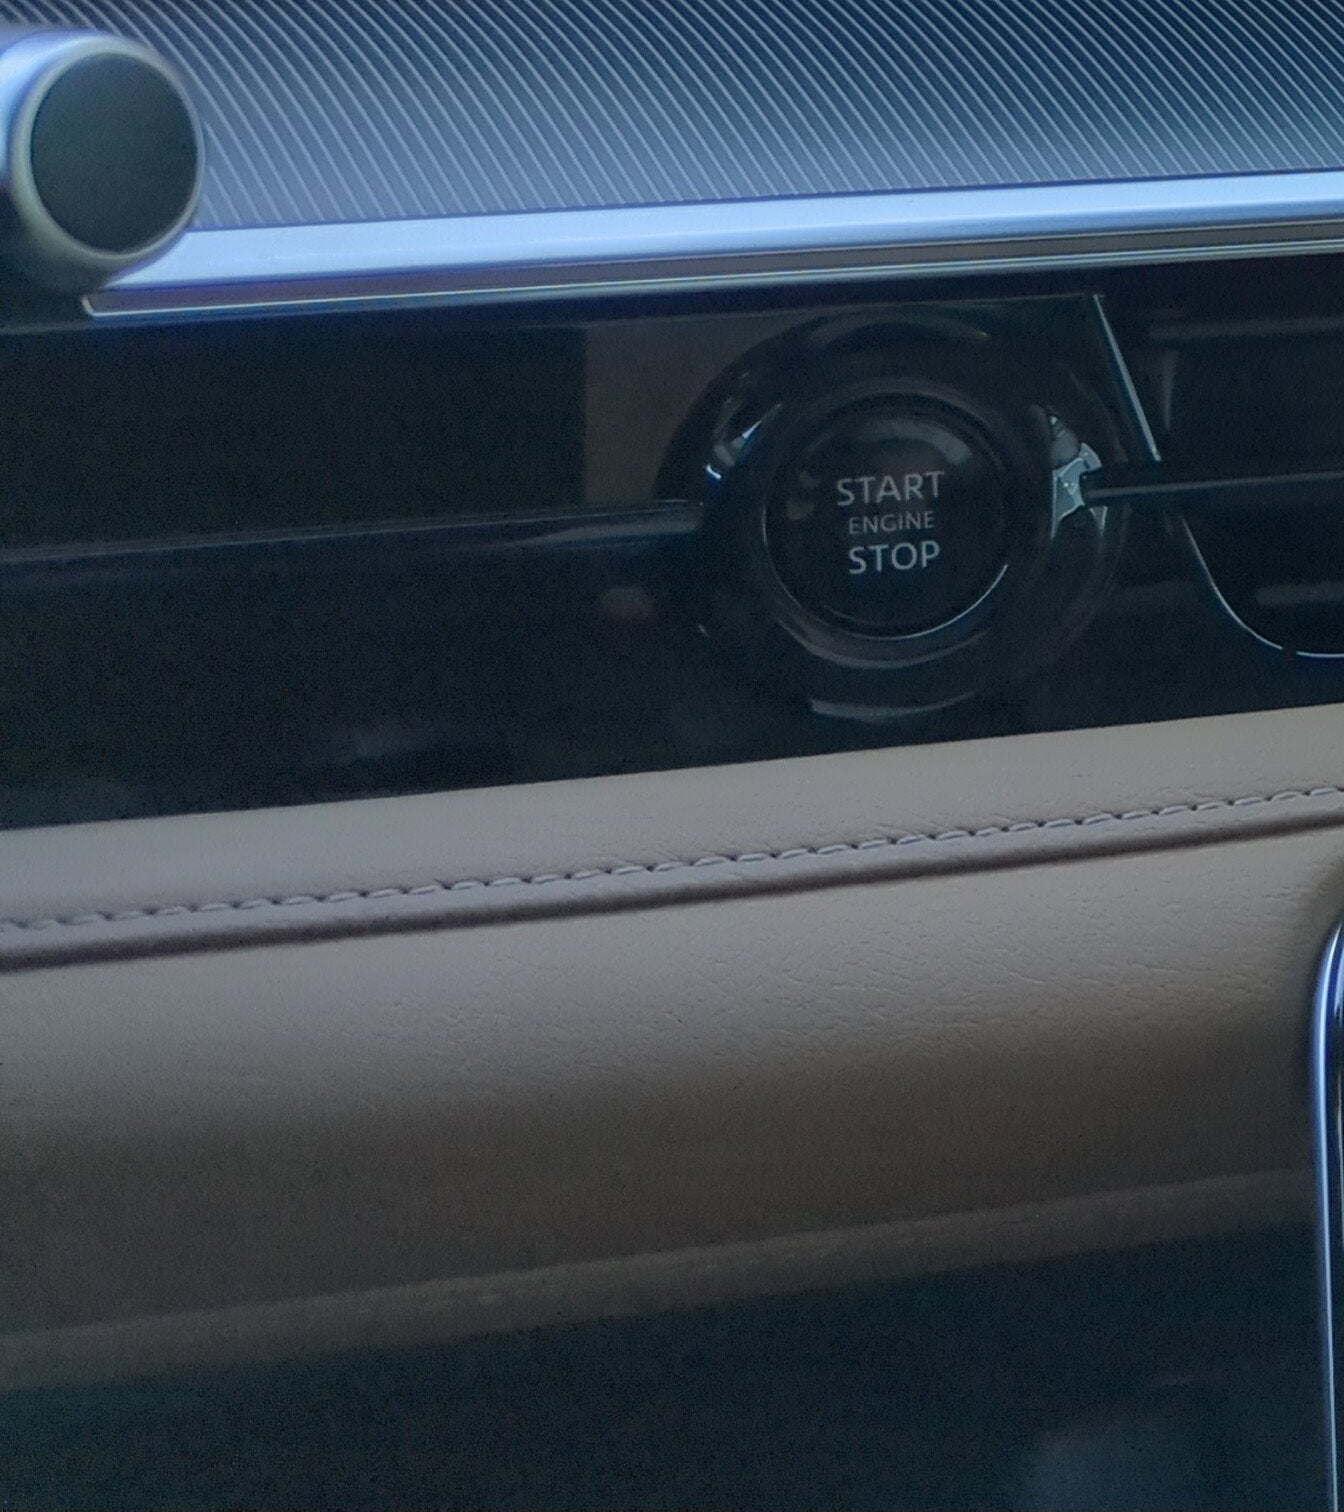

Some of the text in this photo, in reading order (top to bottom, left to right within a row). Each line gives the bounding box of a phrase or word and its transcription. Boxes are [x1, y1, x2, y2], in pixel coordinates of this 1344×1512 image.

[836, 469, 946, 507] START
[848, 509, 934, 536] ENGINE
[848, 539, 941, 576] STOP
